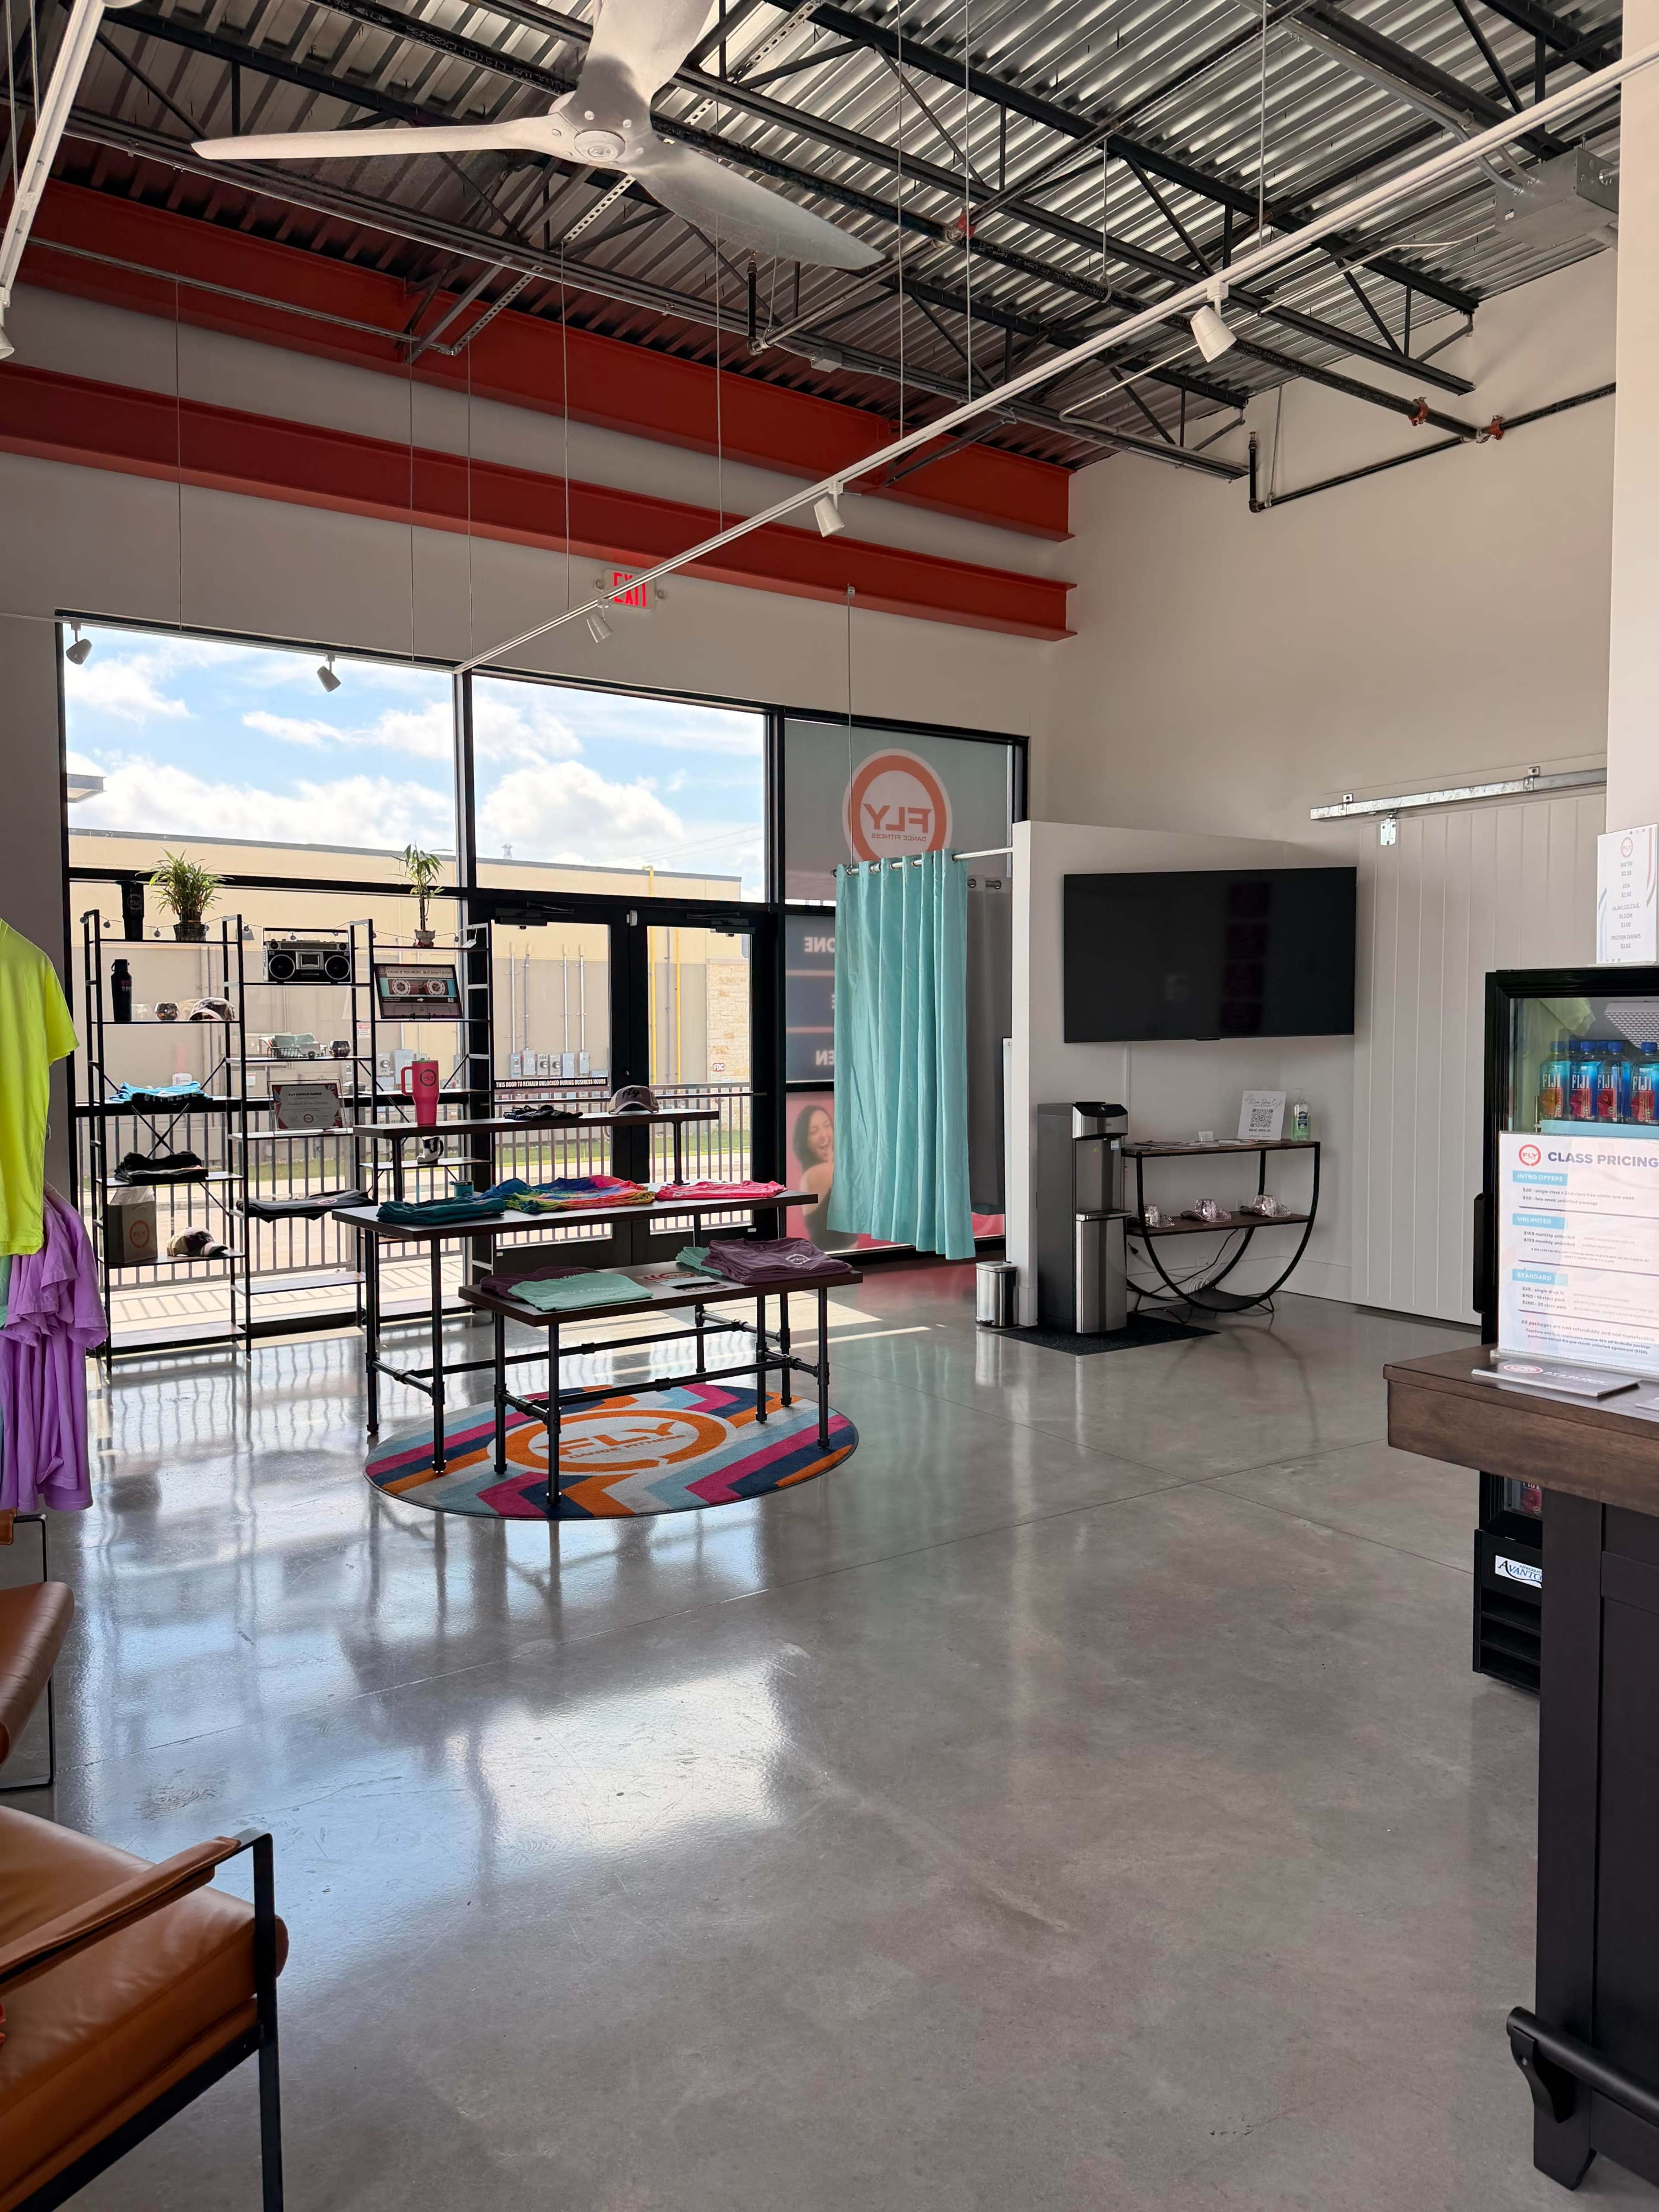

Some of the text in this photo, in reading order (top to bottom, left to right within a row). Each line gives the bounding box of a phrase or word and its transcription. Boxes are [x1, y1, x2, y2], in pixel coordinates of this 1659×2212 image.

[1542, 1074, 1560, 1088] FIJI
[1572, 1075, 1590, 1089] FIJI
[1598, 1075, 1614, 1088] FIJI
[1633, 1076, 1651, 1091] FIJI
[1548, 1152, 1659, 1168] CLASS PRICING
[1517, 1216, 1551, 1225] UNLIMITED
[133, 1230, 147, 1238] FLY
[1517, 1272, 1552, 1281] STANDARD
[532, 1421, 676, 1455] FLY
[569, 1434, 685, 1459] DANCE FITNESS
